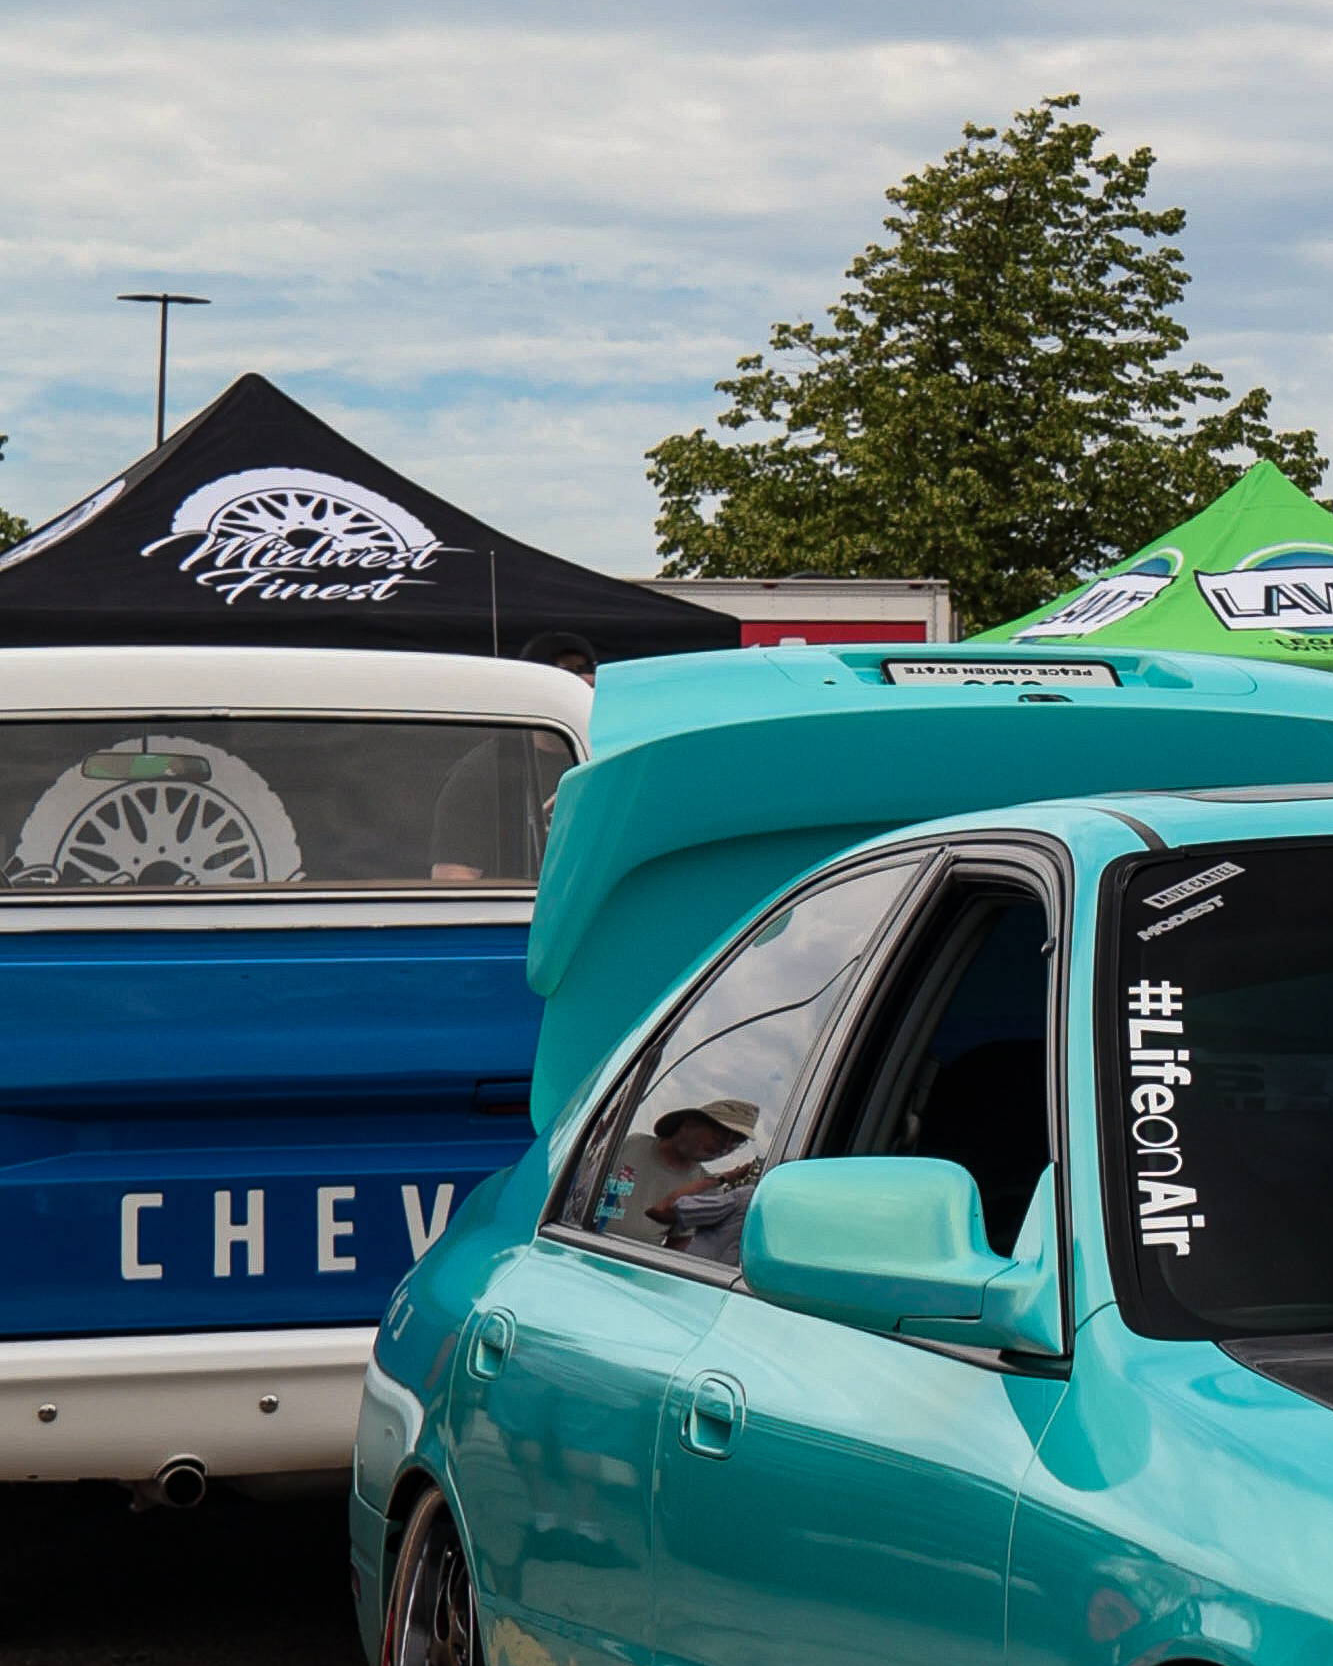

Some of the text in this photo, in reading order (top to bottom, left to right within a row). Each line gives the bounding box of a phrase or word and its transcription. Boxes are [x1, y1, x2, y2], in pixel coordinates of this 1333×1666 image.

[140, 530, 475, 572] Midwest
[196, 567, 438, 605] Finest
[963, 667, 1033, 676] GARDEN
[1189, 865, 1238, 888] CARTEL
[121, 1184, 455, 1280] CHEV
